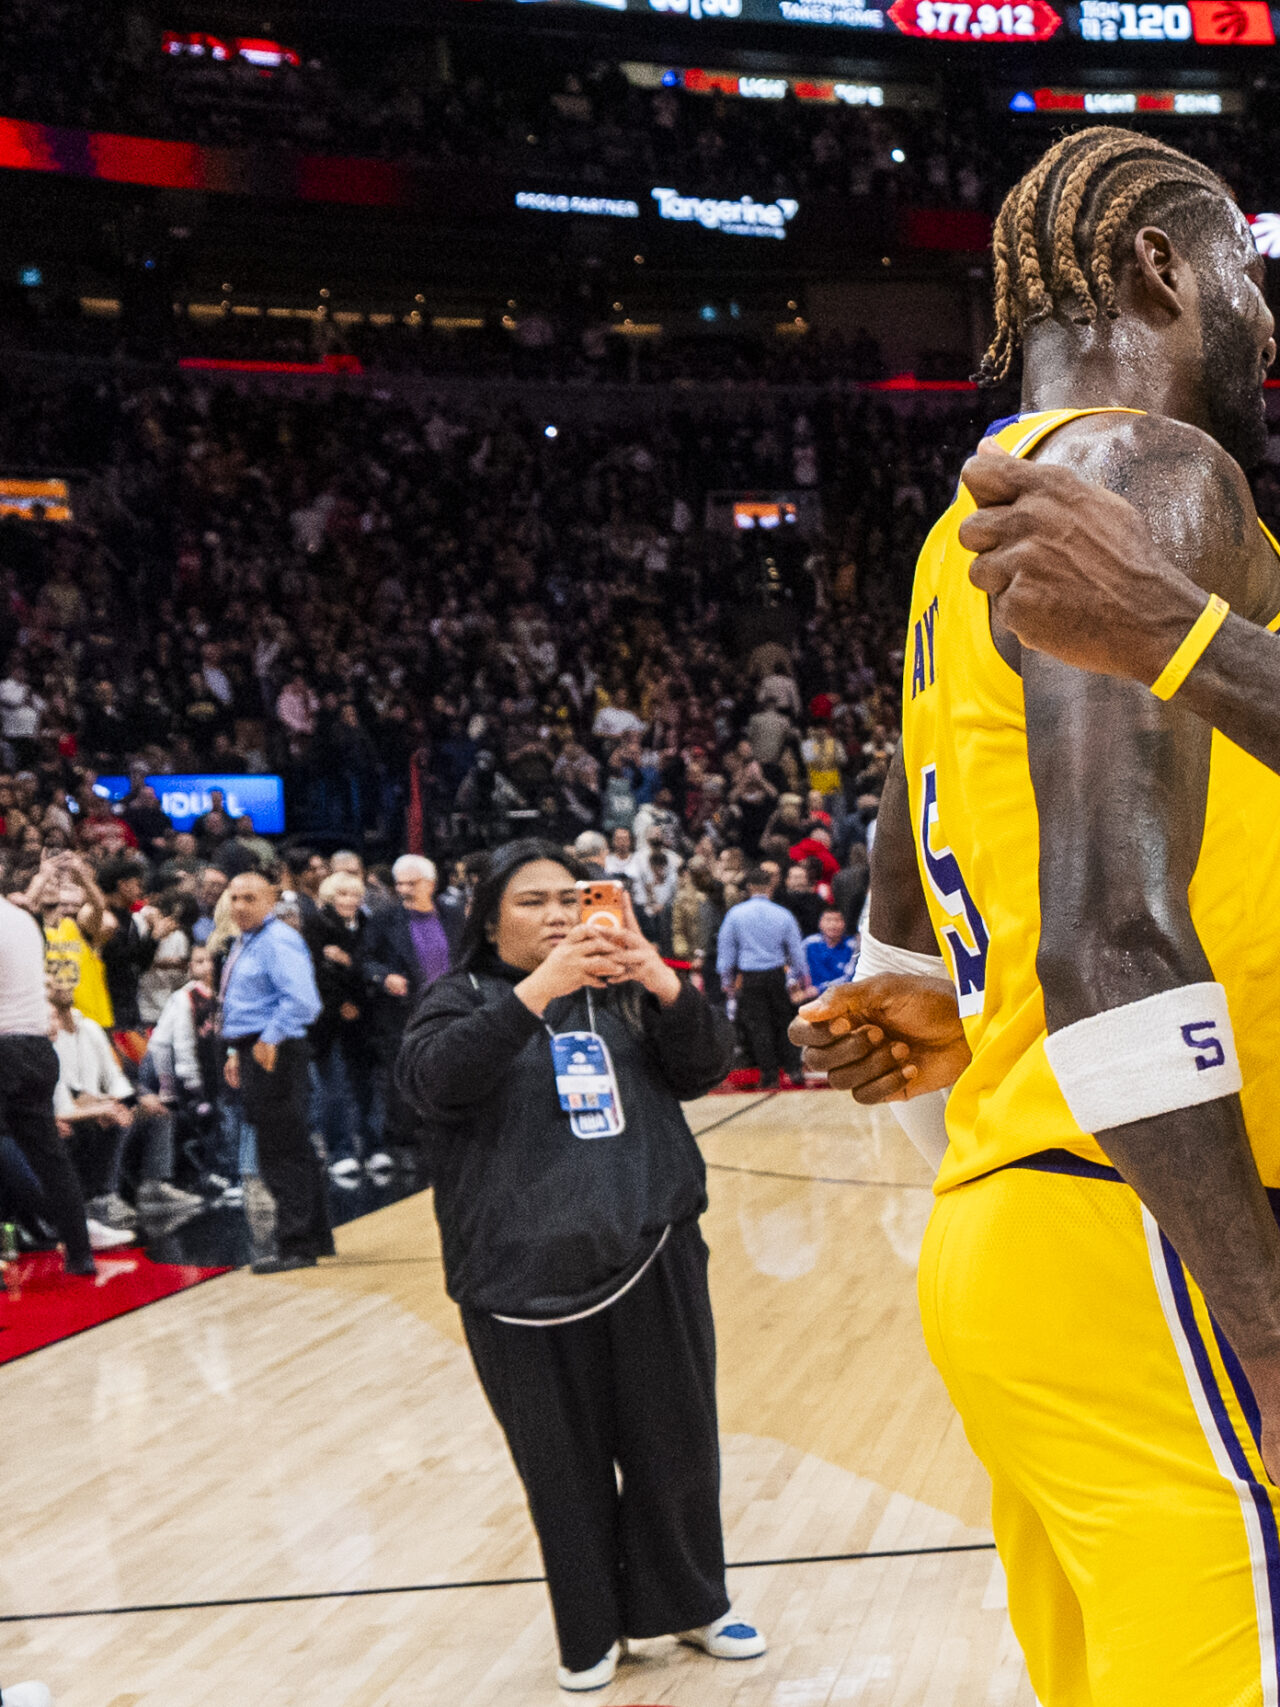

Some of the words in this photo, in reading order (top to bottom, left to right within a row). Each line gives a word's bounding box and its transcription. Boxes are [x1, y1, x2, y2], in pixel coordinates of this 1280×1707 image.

[916, 1, 1034, 38] $77,912
[1118, 5, 1192, 41] 120
[515, 191, 569, 212] PROUD
[651, 187, 785, 229] Tangerine
